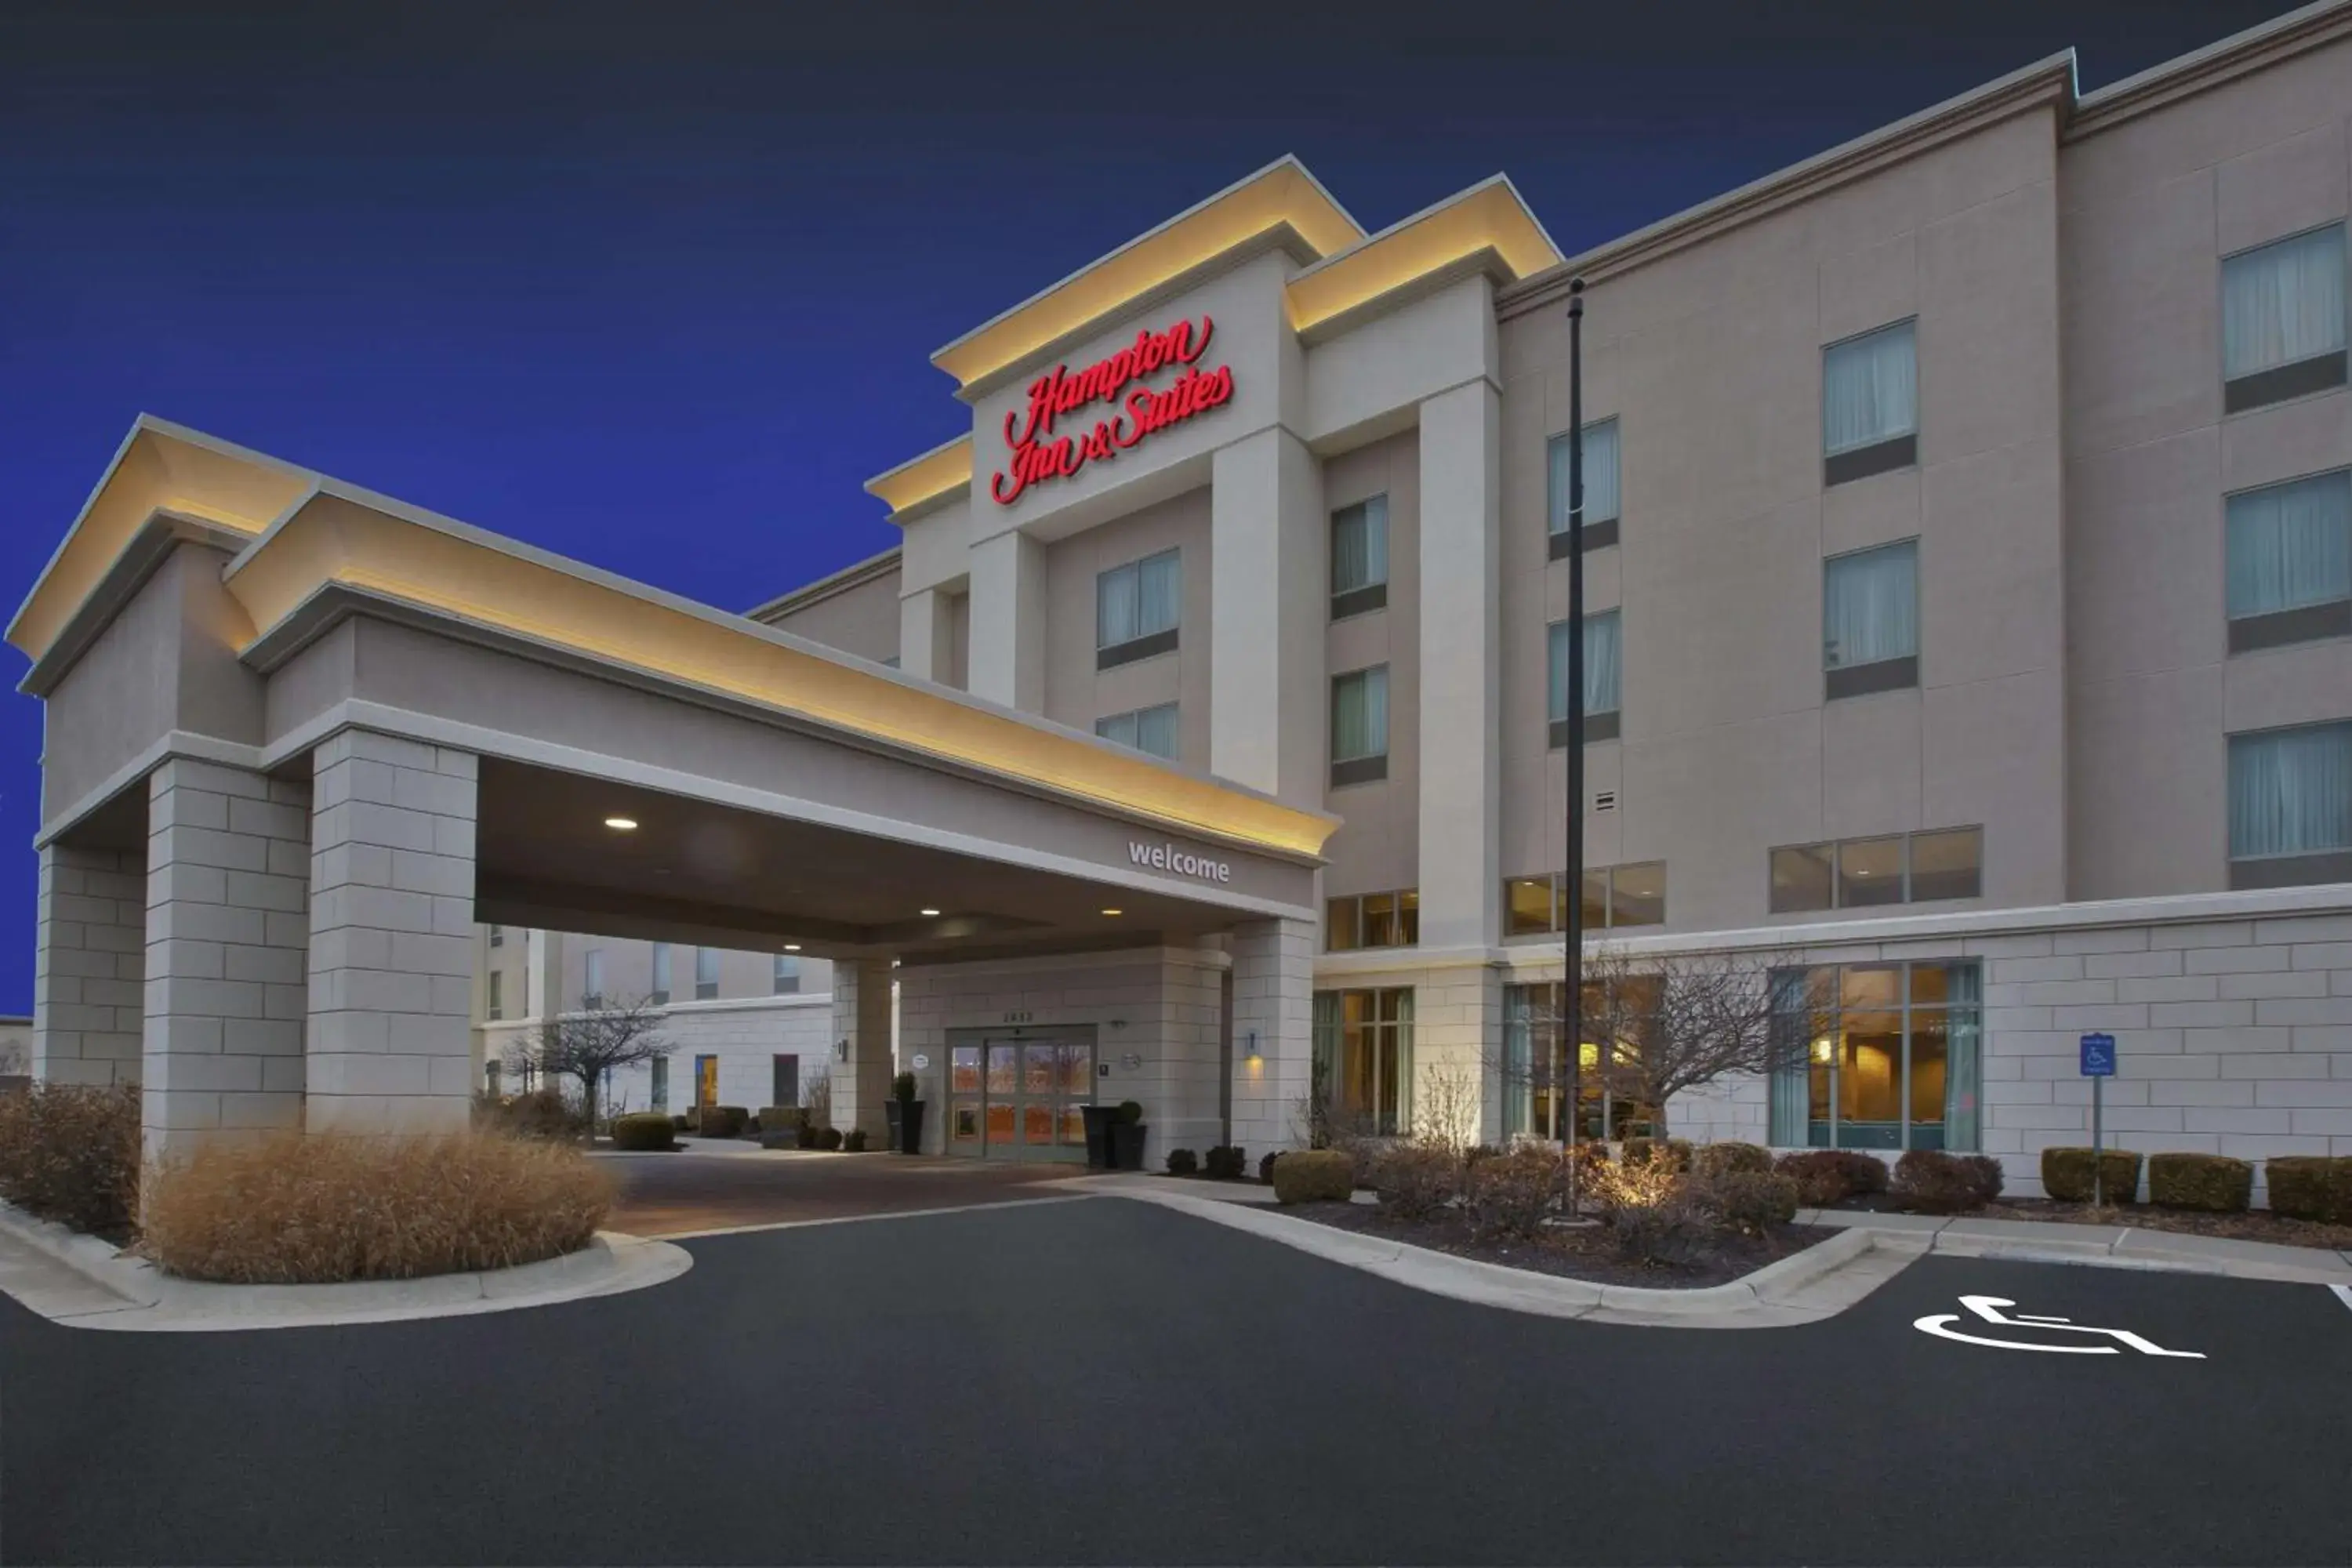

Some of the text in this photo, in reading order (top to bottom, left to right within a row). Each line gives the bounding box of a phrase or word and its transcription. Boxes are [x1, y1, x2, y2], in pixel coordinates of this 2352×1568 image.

[992, 365, 1233, 505] Inn & Suites
[1004, 314, 1213, 451] Hampton
[1128, 840, 1230, 883] welcome
